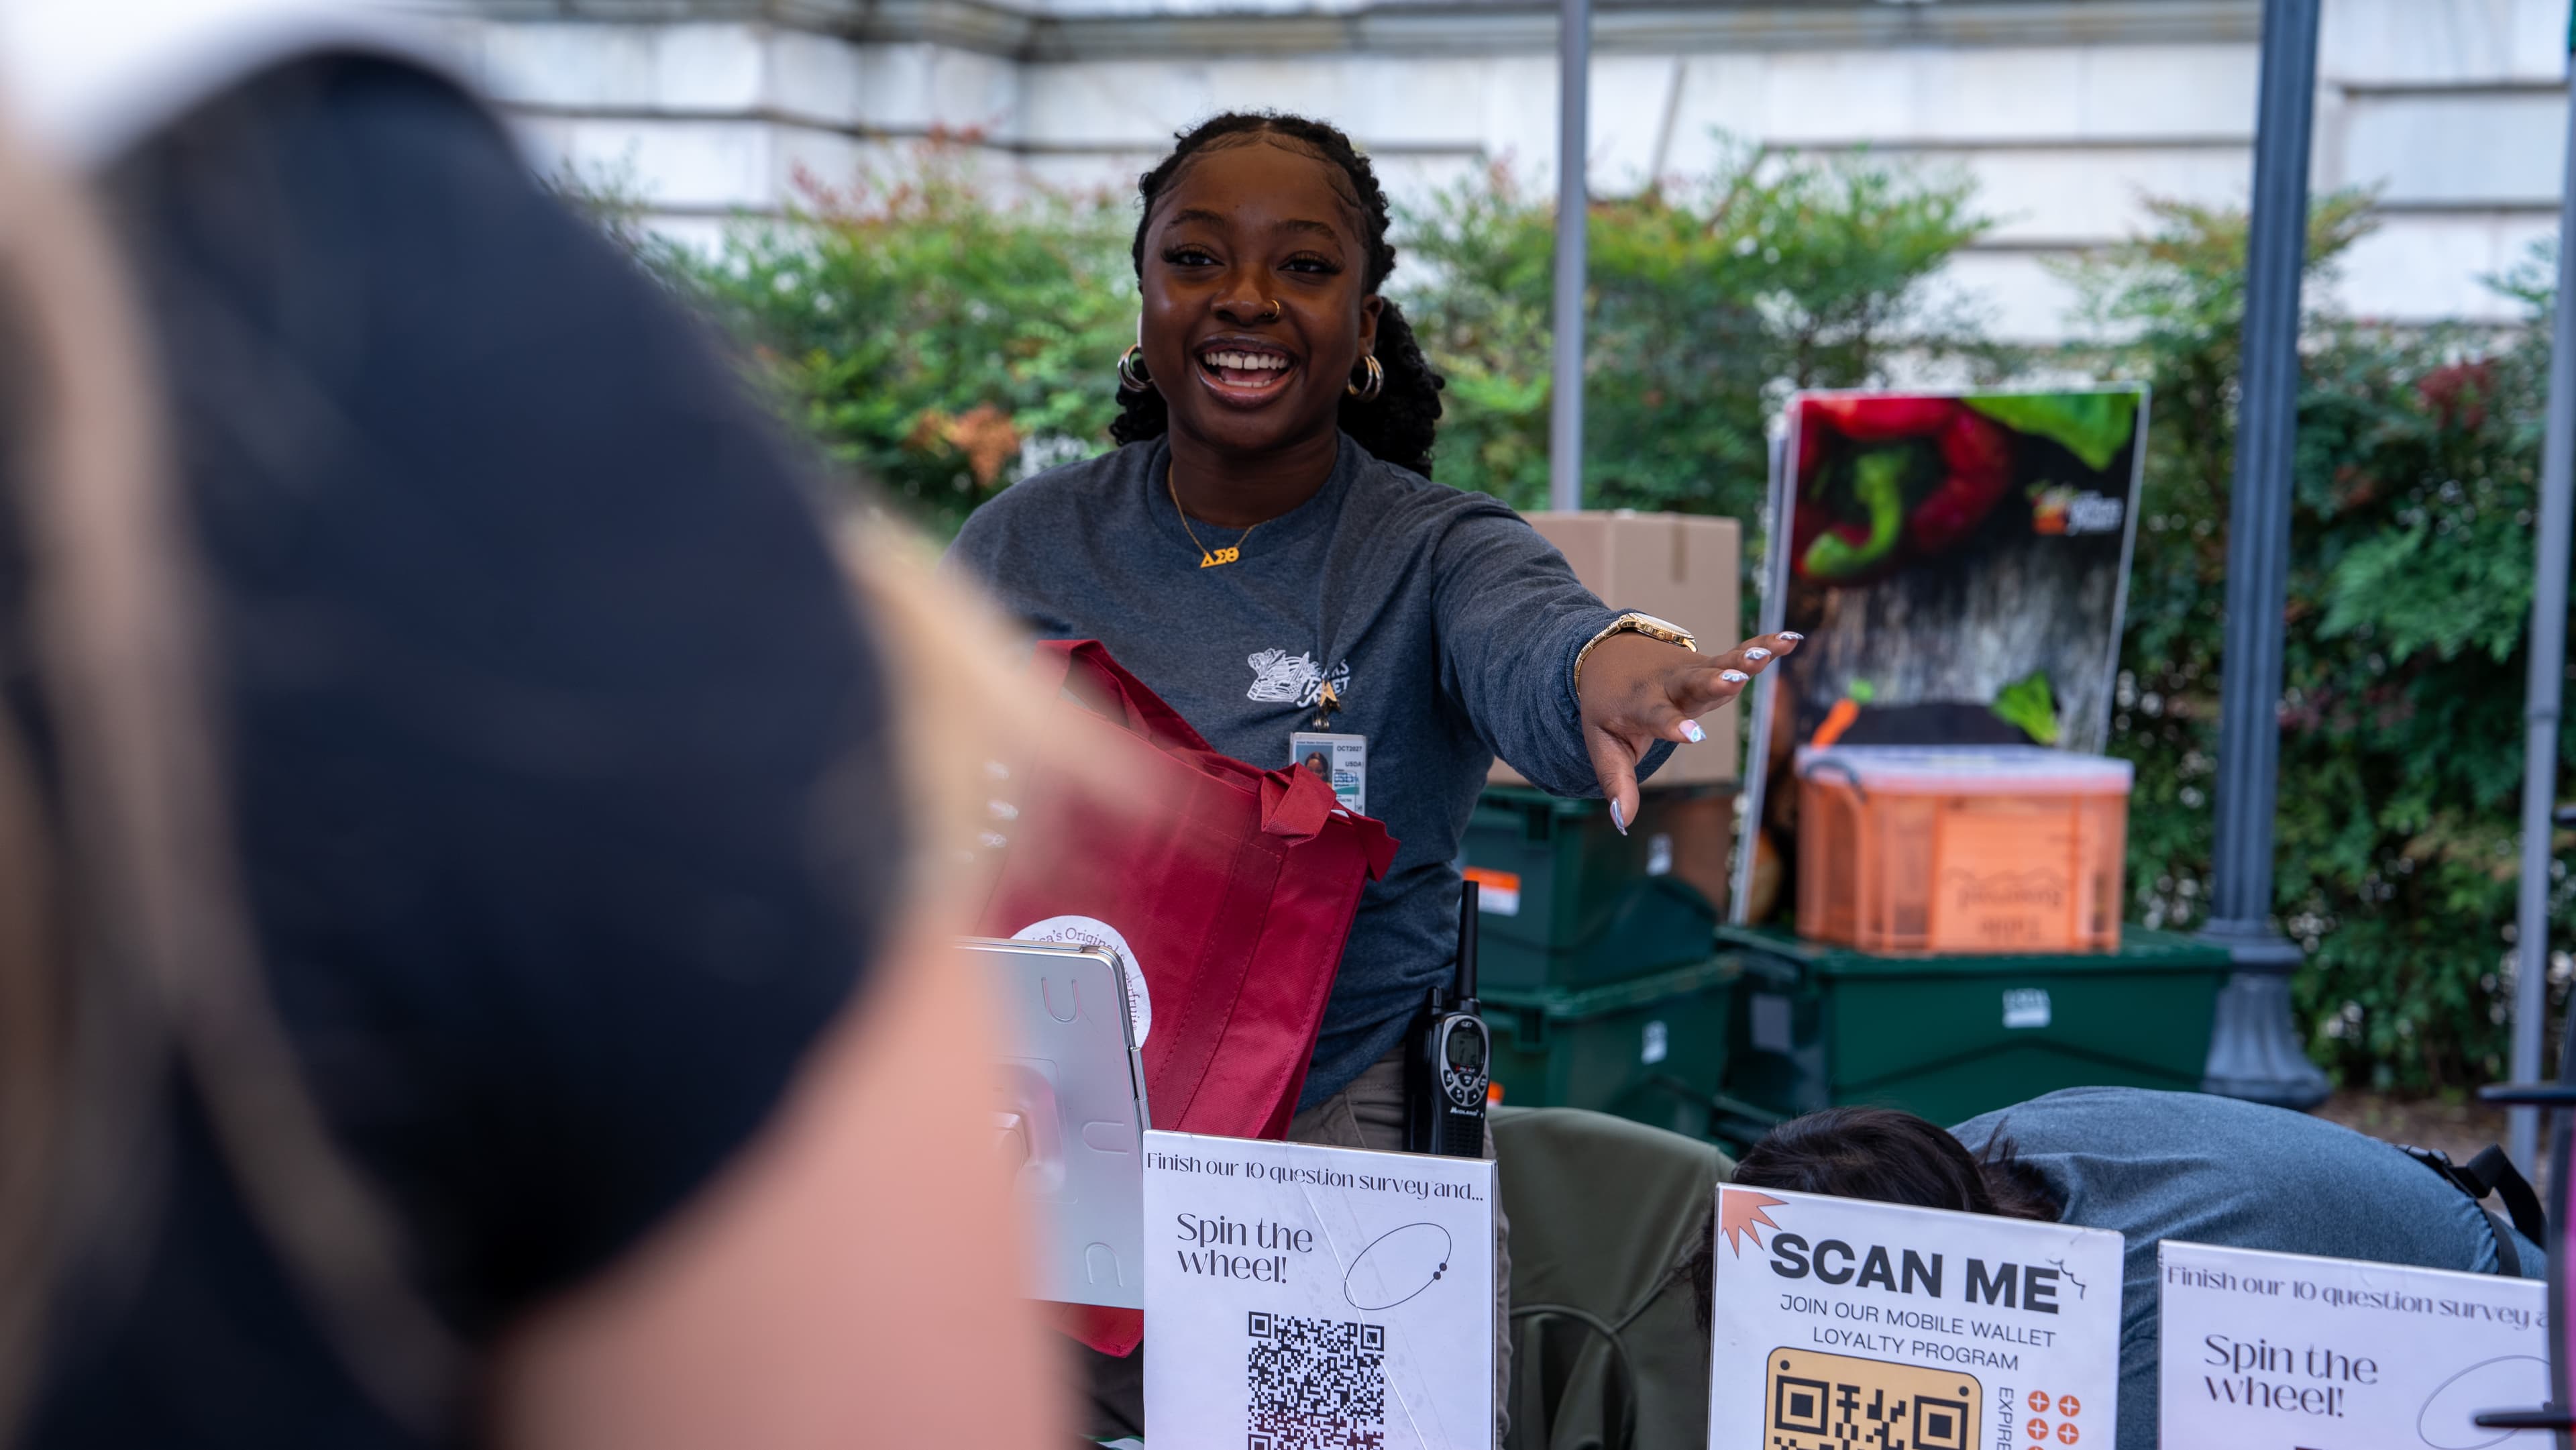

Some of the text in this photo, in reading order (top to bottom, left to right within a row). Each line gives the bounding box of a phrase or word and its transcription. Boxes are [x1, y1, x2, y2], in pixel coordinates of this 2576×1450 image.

[1146, 1151, 1484, 1202] Finish our 10 question survey and...
[1177, 1212, 1313, 1253] Spin the
[1177, 1249, 1287, 1284] wheel!
[1770, 1233, 2059, 1314] SCAN ME
[1780, 1294, 2056, 1348] JOIN OUR MOBILE WALLET
[2167, 1265, 2237, 1292] Finish
[2243, 1274, 2286, 1296] our
[2292, 1280, 2316, 1300] 10
[2322, 1286, 2433, 1314] question
[2438, 1300, 2530, 1332] survey
[1813, 1326, 2019, 1371] LOYALTY PROGRAM
[2204, 1333, 2378, 1385] Spin the
[2204, 1375, 2345, 1418] wheel!
